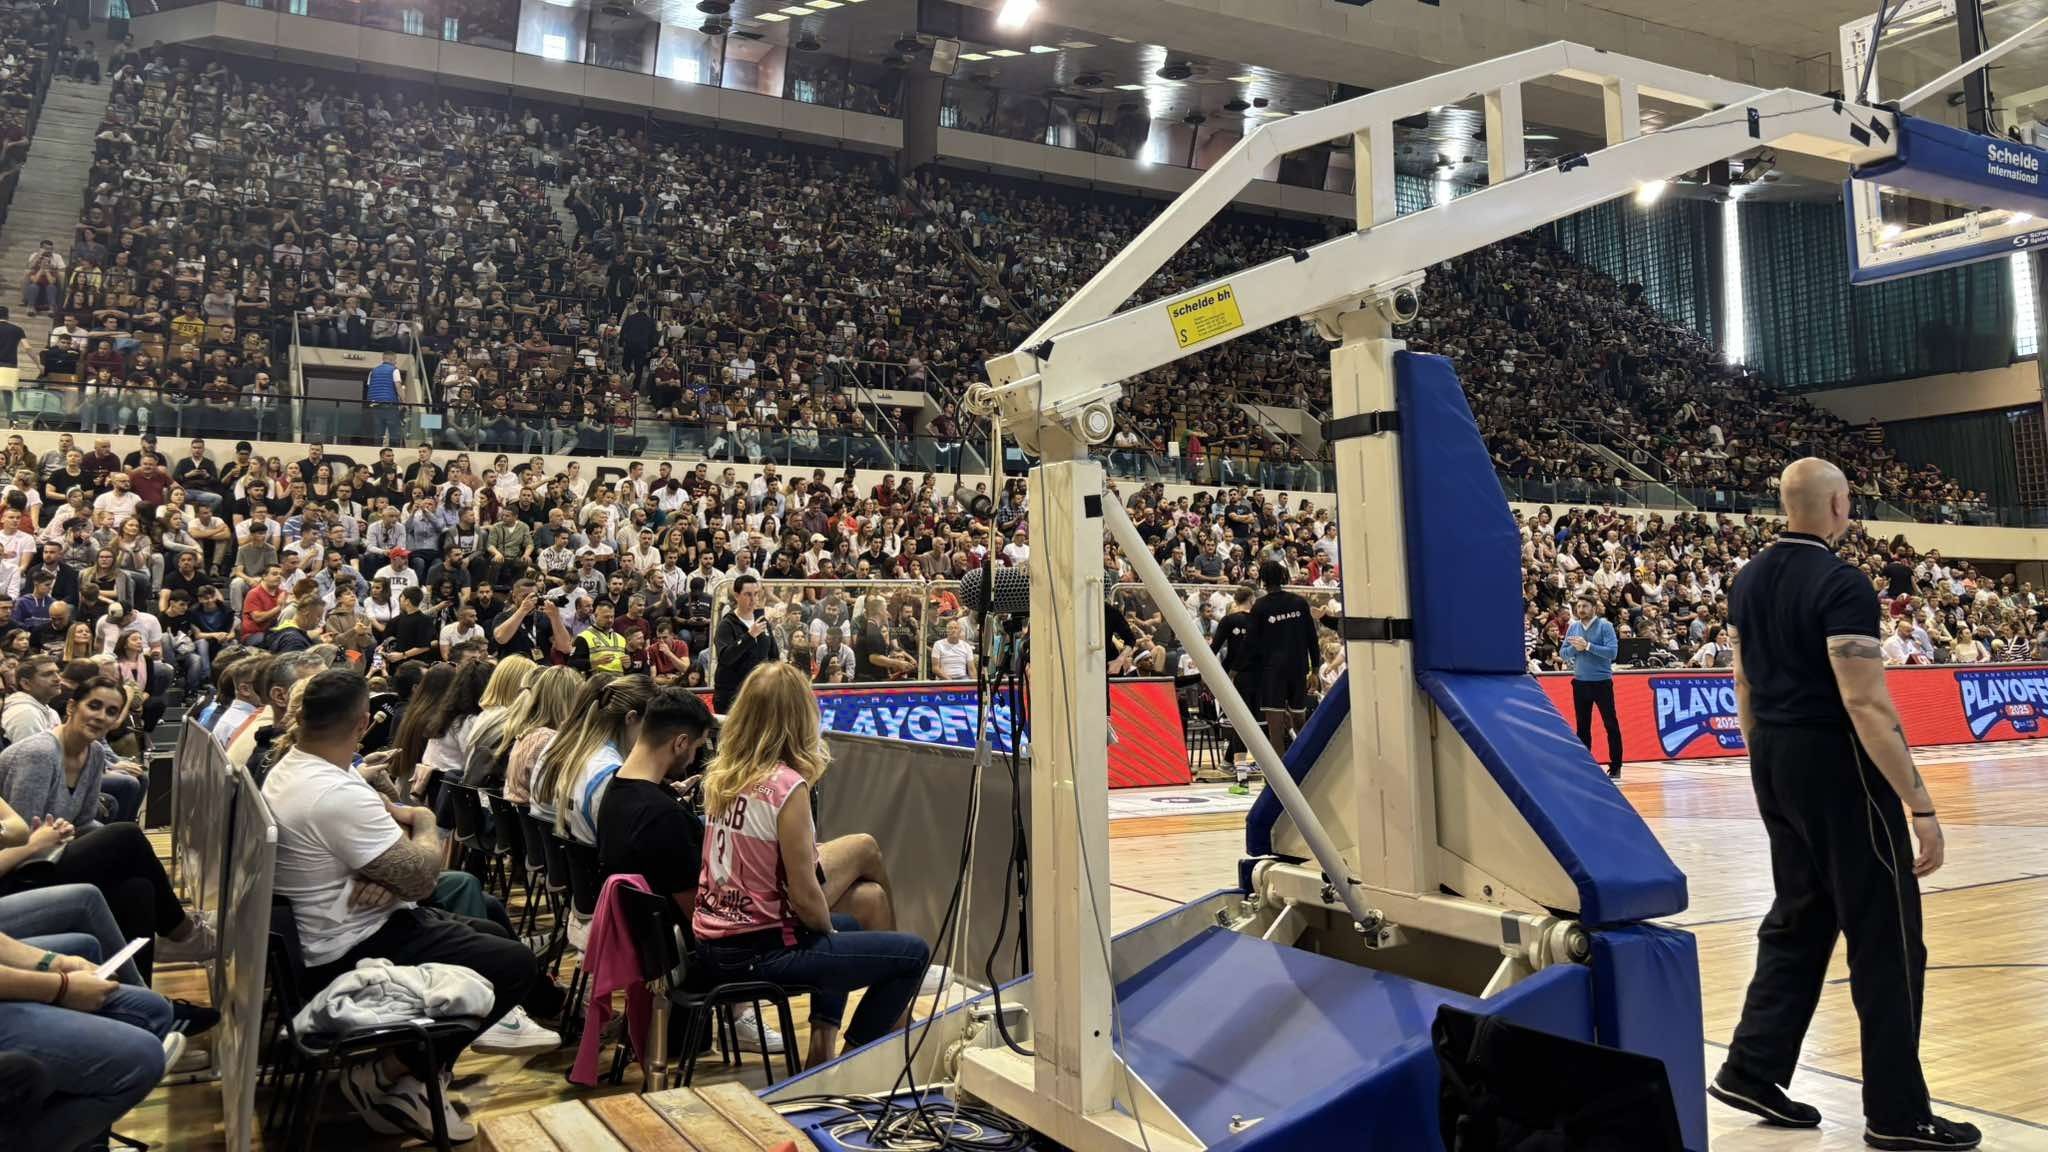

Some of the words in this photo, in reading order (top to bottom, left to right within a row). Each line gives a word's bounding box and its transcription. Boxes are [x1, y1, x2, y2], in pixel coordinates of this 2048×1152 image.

[1988, 144, 2039, 171] Schelde
[1988, 163, 2038, 184] International
[1172, 296, 1215, 318] schelde
